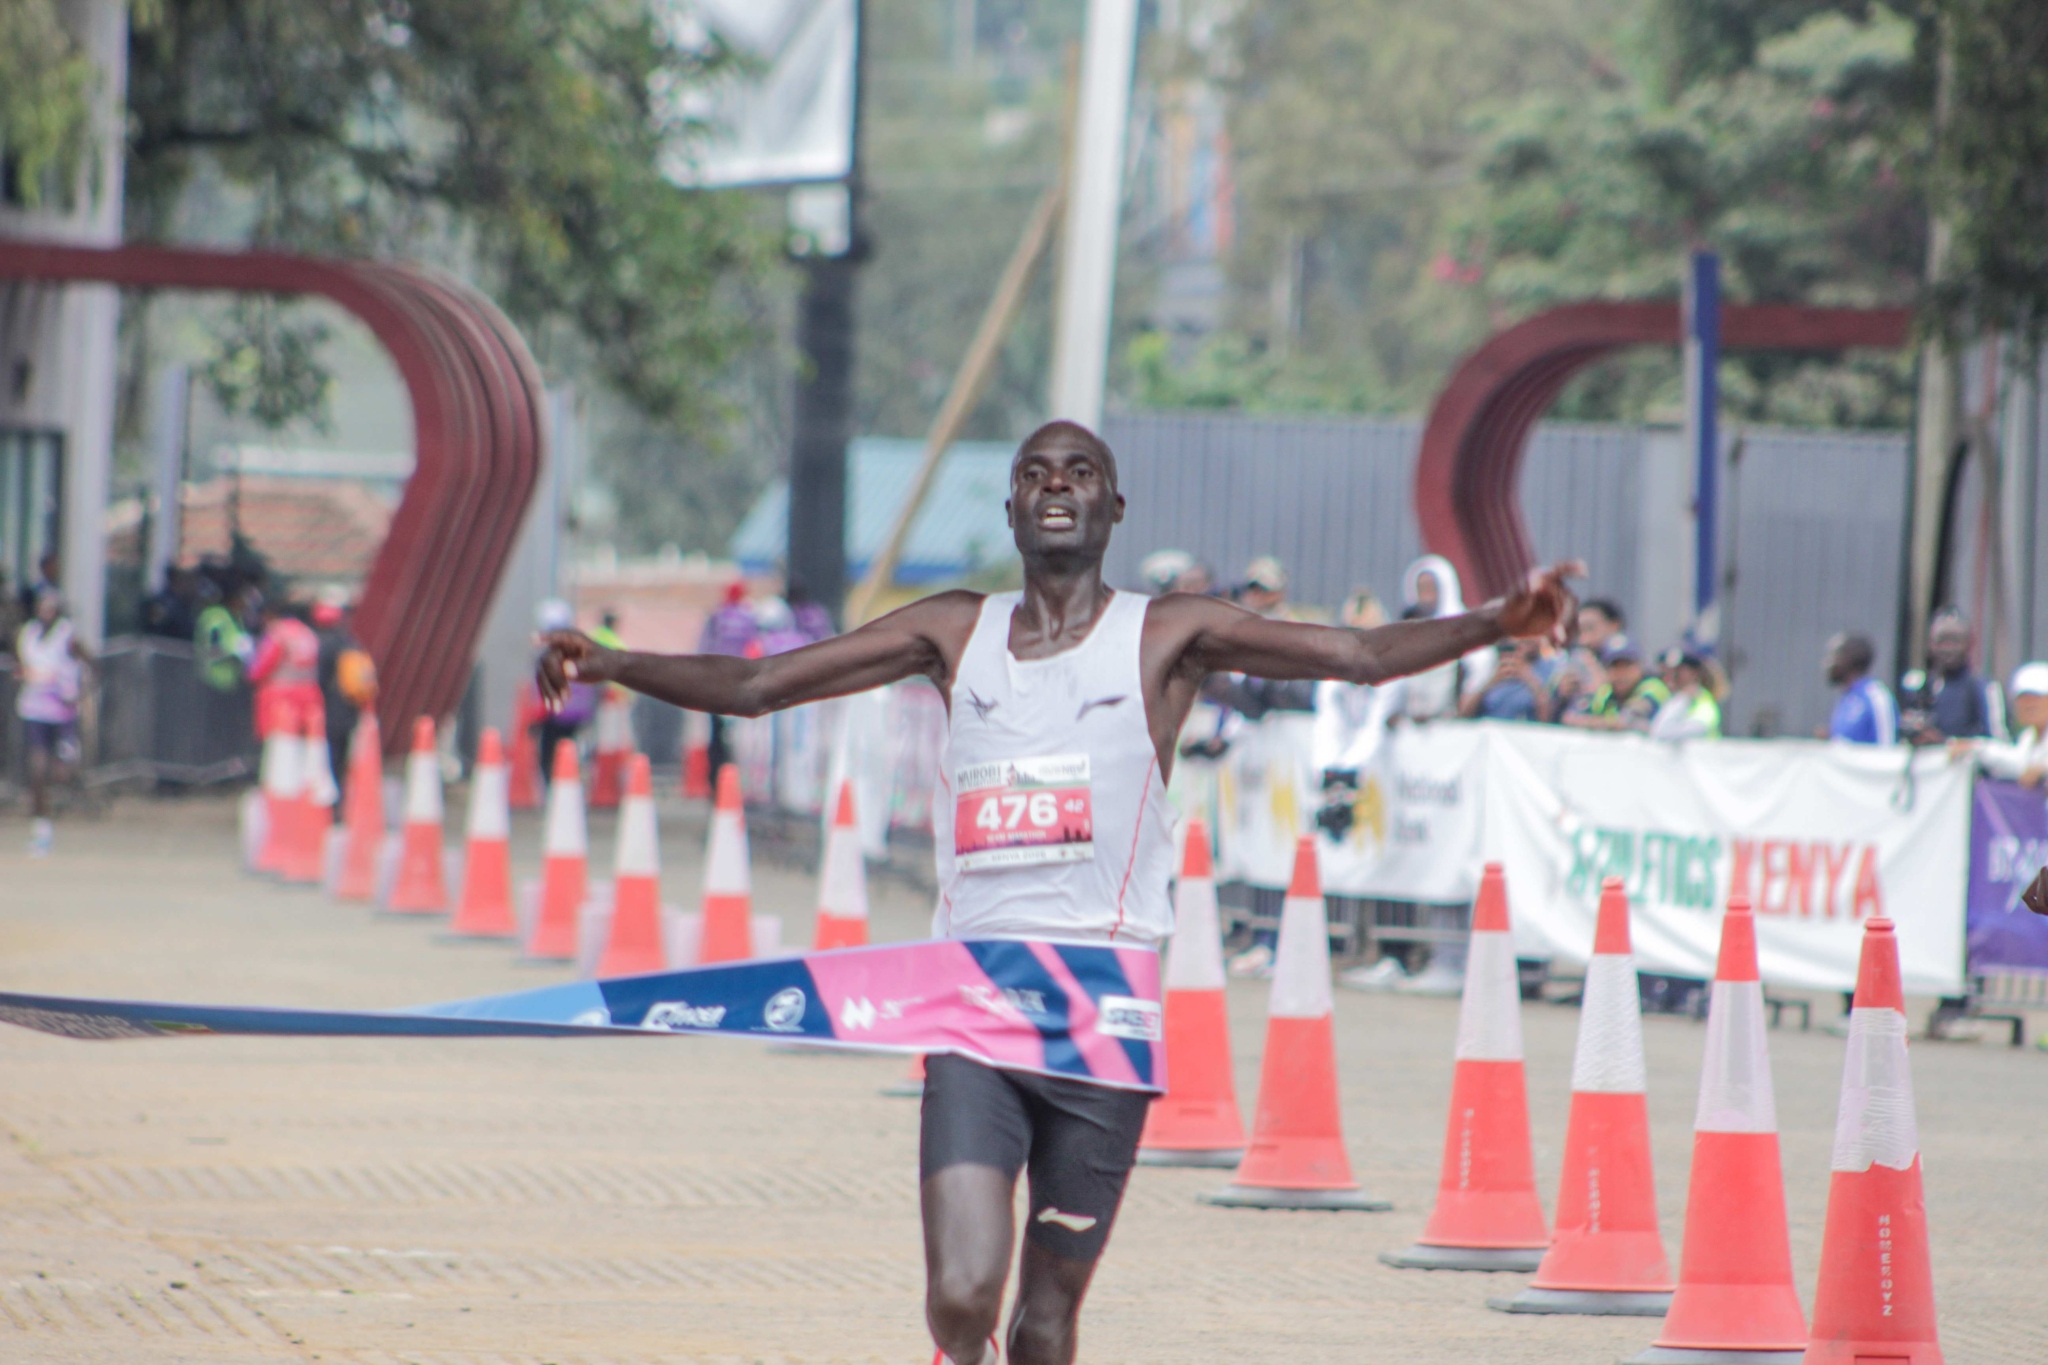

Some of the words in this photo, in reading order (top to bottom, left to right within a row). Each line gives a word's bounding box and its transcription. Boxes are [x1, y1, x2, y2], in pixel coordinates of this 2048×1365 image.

[976, 792, 1059, 830] 476
[1063, 798, 1084, 813] 42
[1729, 837, 1884, 920] KENYA
